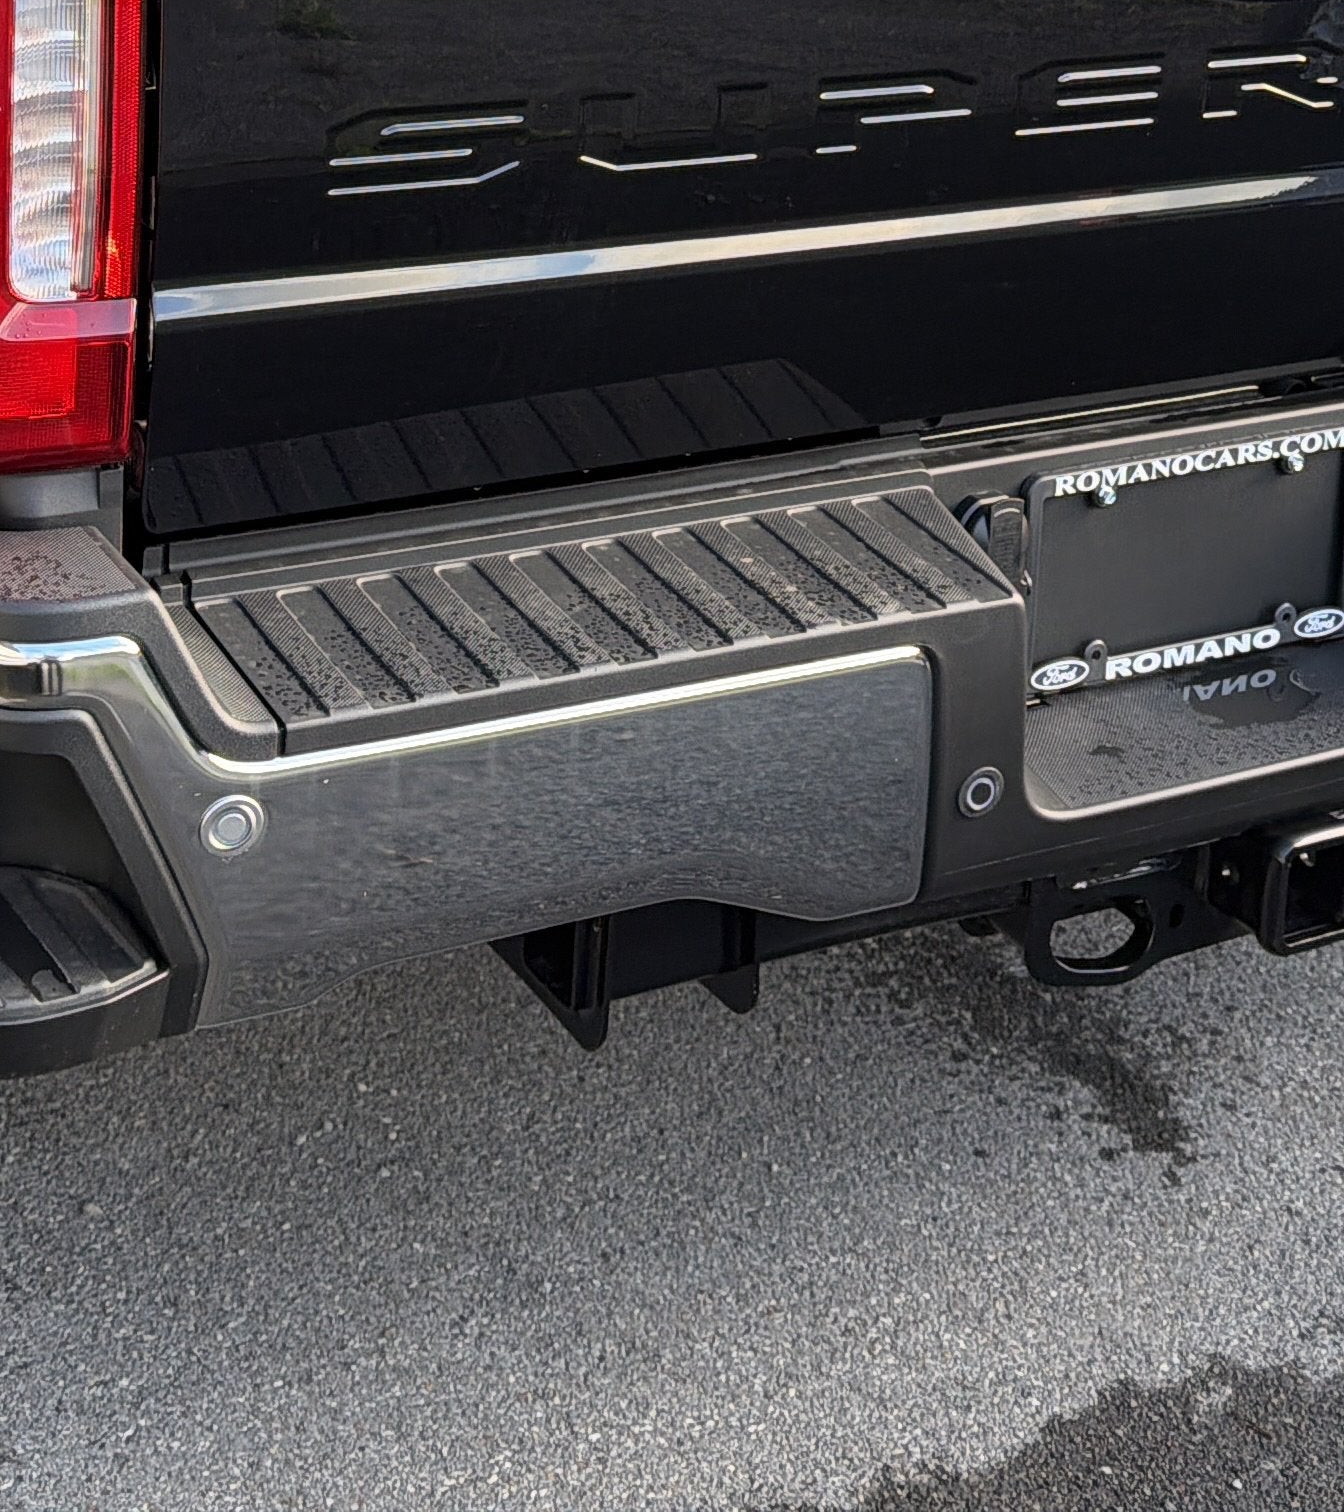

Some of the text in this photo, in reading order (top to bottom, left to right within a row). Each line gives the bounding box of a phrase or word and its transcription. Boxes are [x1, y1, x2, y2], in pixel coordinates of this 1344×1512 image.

[326, 47, 1337, 196] SUPER
[1042, 613, 1336, 685] Ford ROMANO Ford
